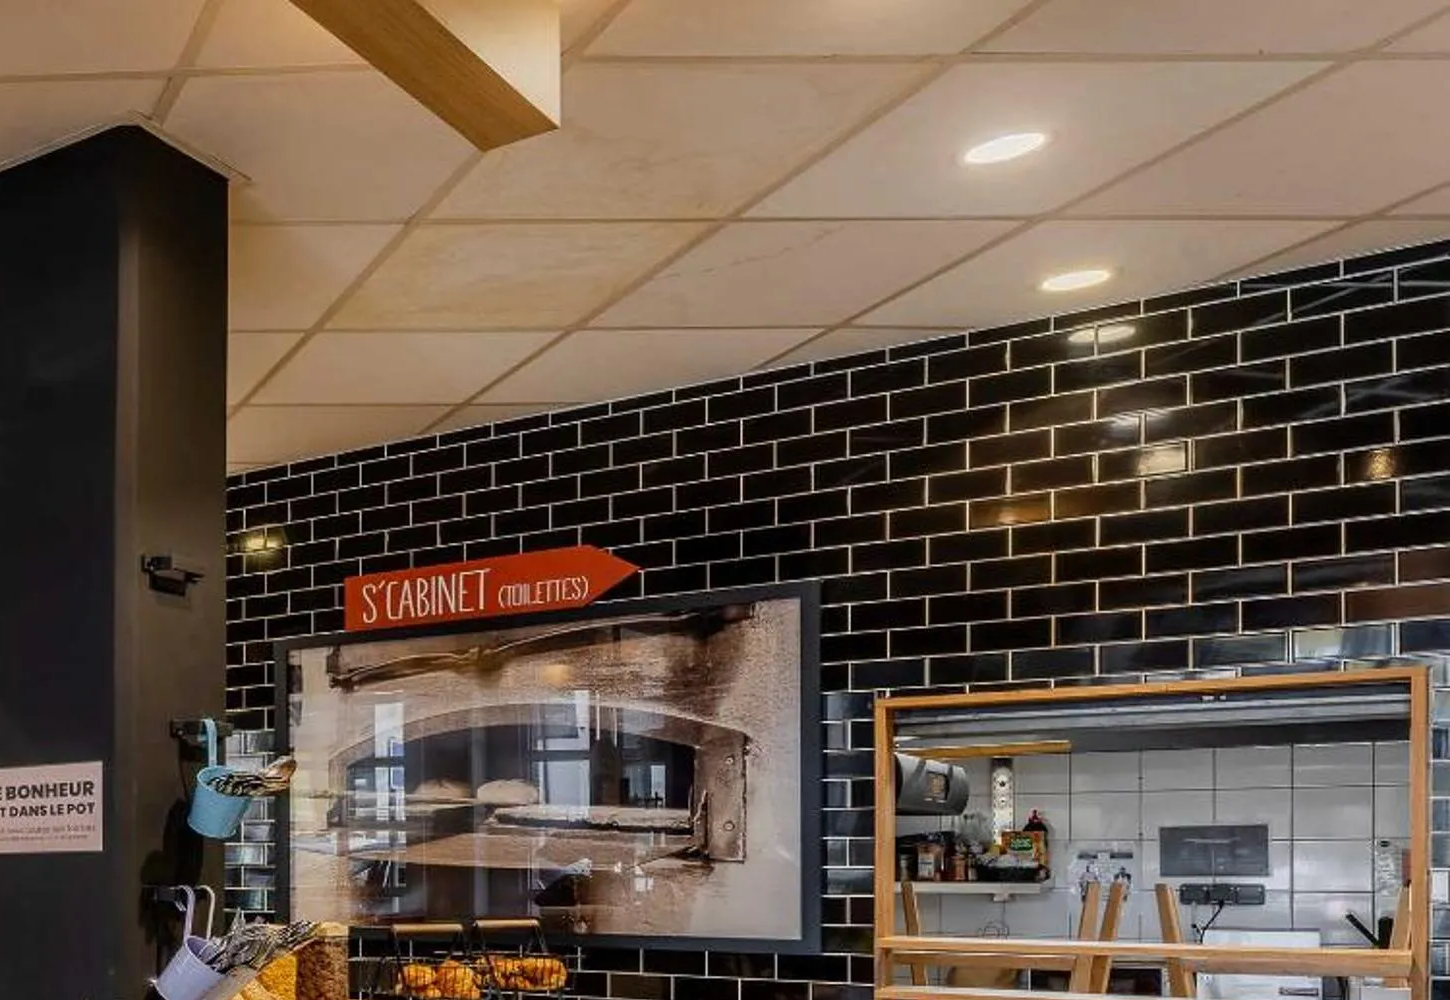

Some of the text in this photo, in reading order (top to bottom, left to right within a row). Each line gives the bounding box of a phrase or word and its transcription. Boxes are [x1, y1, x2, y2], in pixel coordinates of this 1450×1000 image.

[497, 575, 589, 608] (TOILETTES)
[5, 780, 95, 801] BONHEUR
[8, 805, 48, 818] DANS
[50, 804, 65, 816] LE
[67, 802, 96, 815] POT
